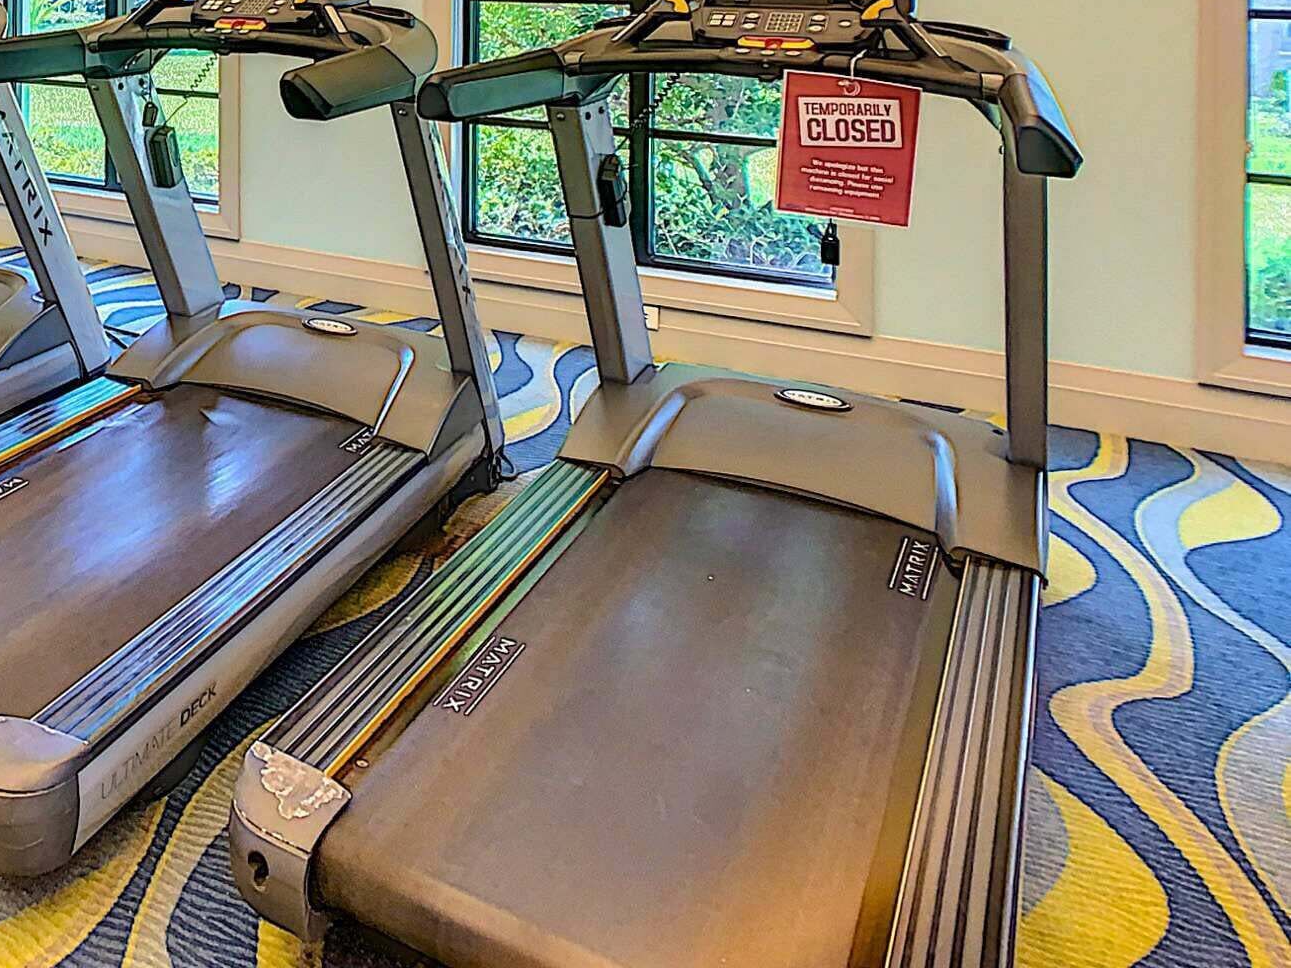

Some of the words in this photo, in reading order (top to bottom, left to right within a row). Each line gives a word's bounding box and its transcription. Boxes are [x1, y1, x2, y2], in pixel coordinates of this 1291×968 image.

[804, 102, 892, 116] TEMPORARILY
[806, 118, 896, 143] CLOSED
[897, 538, 930, 599] MATRIX
[441, 635, 518, 714] MATRIX
[100, 712, 178, 801] ULTIMATE
[178, 681, 218, 728] DECK
